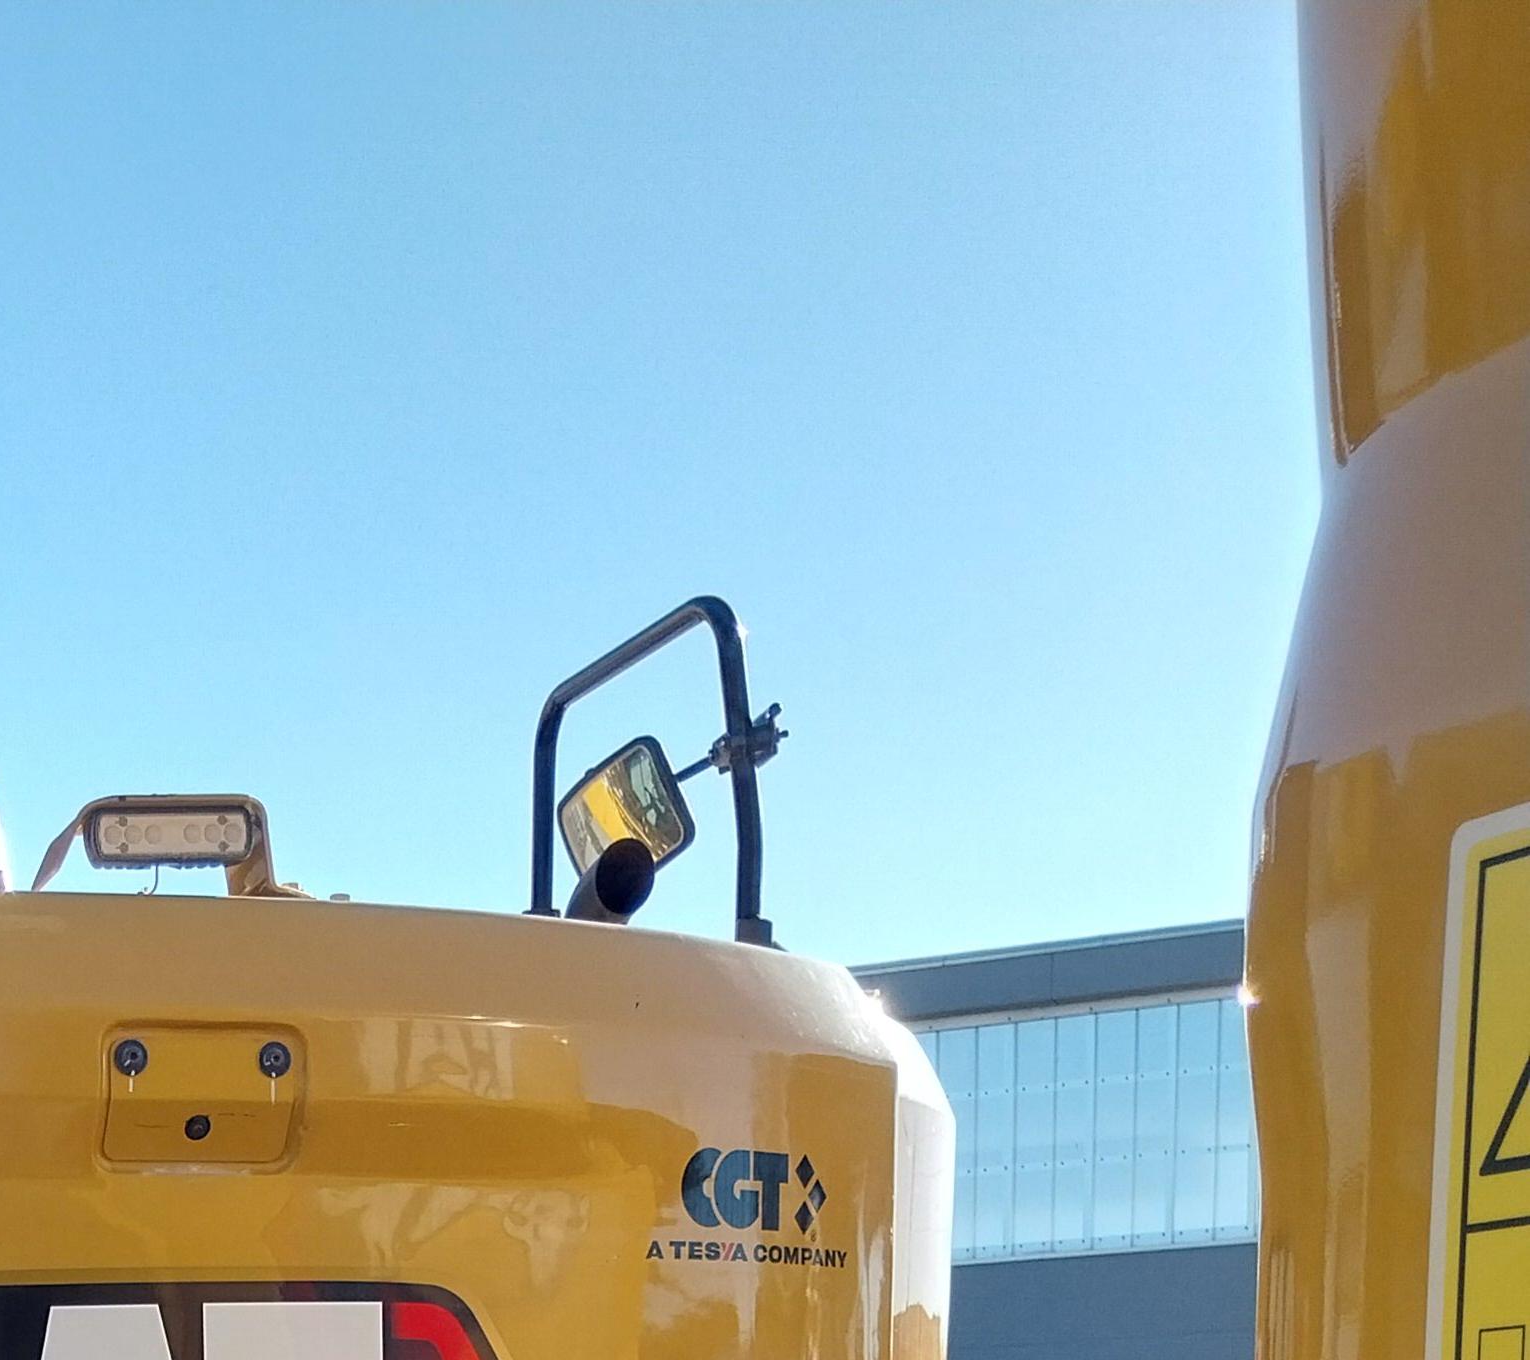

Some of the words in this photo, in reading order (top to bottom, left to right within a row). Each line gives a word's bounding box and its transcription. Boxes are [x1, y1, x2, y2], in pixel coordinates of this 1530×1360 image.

[681, 1147, 789, 1231] CGT
[646, 1240, 664, 1259] A
[754, 1244, 848, 1268] COMPANY
